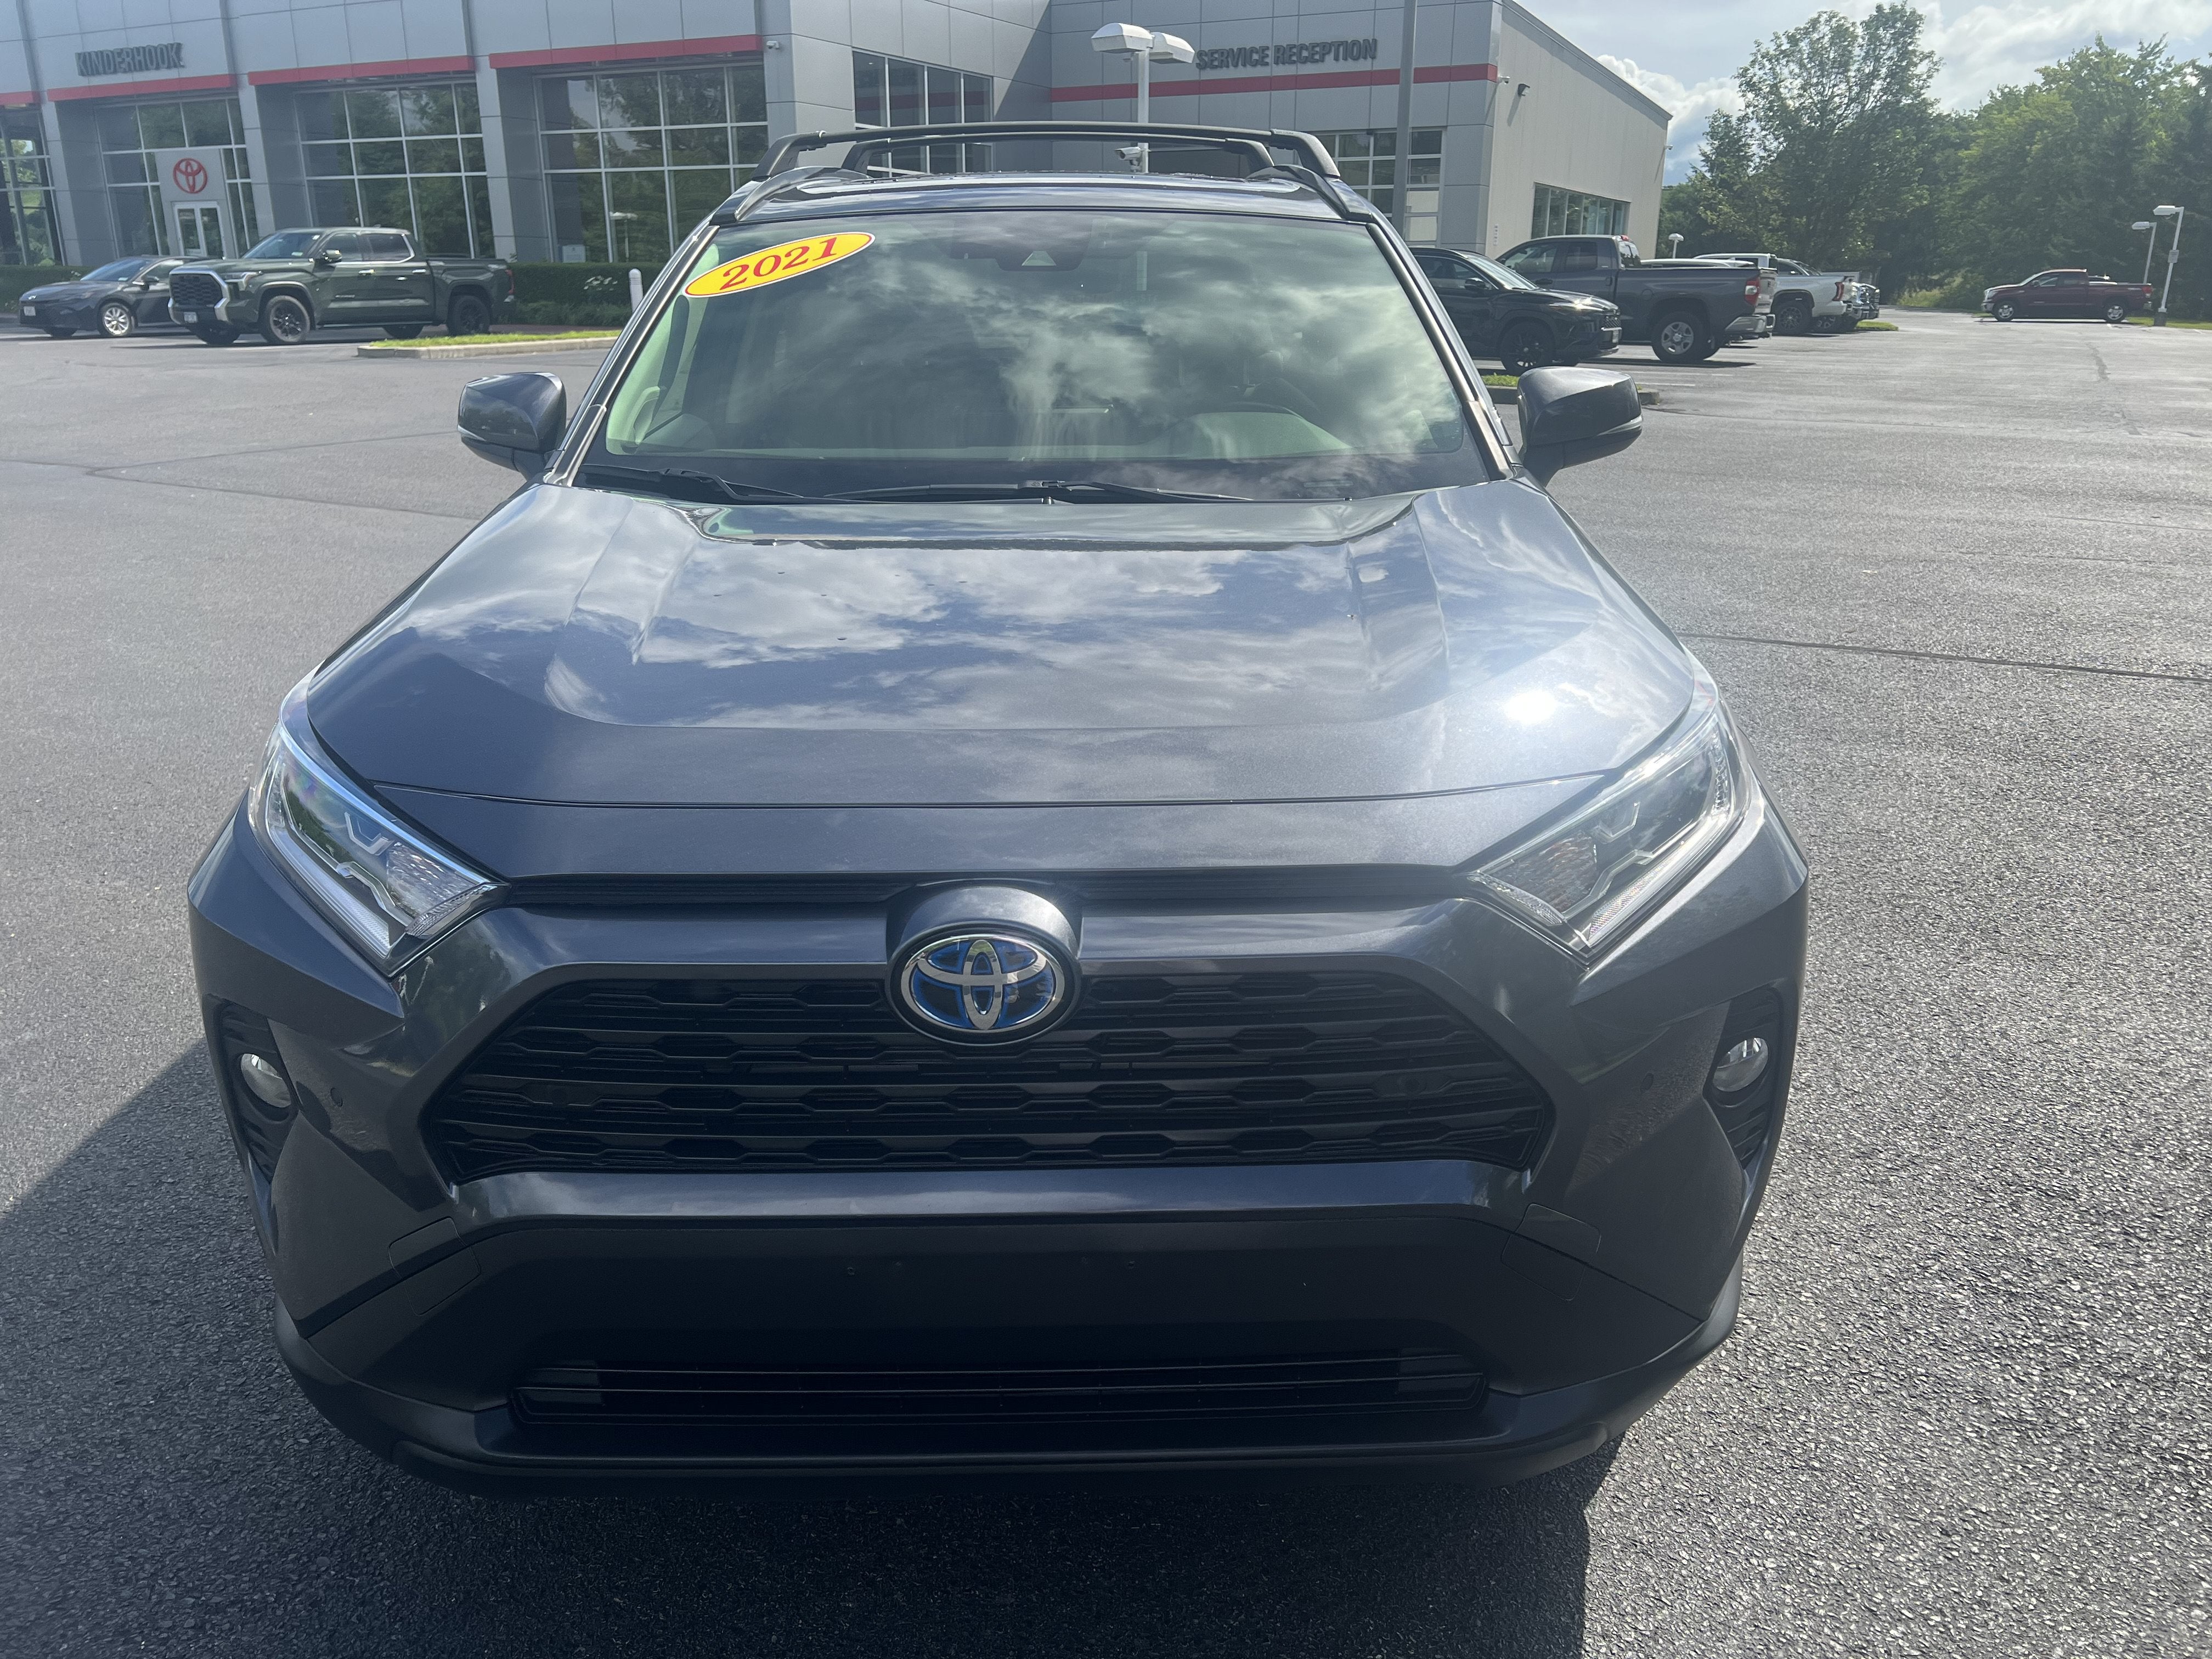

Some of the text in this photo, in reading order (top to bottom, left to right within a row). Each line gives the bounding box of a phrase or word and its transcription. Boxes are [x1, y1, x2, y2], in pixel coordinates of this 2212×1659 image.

[75, 42, 185, 76] KINDERHOOK
[1196, 38, 1378, 70] SERVICE RECEPTION
[719, 237, 838, 290] 2021
